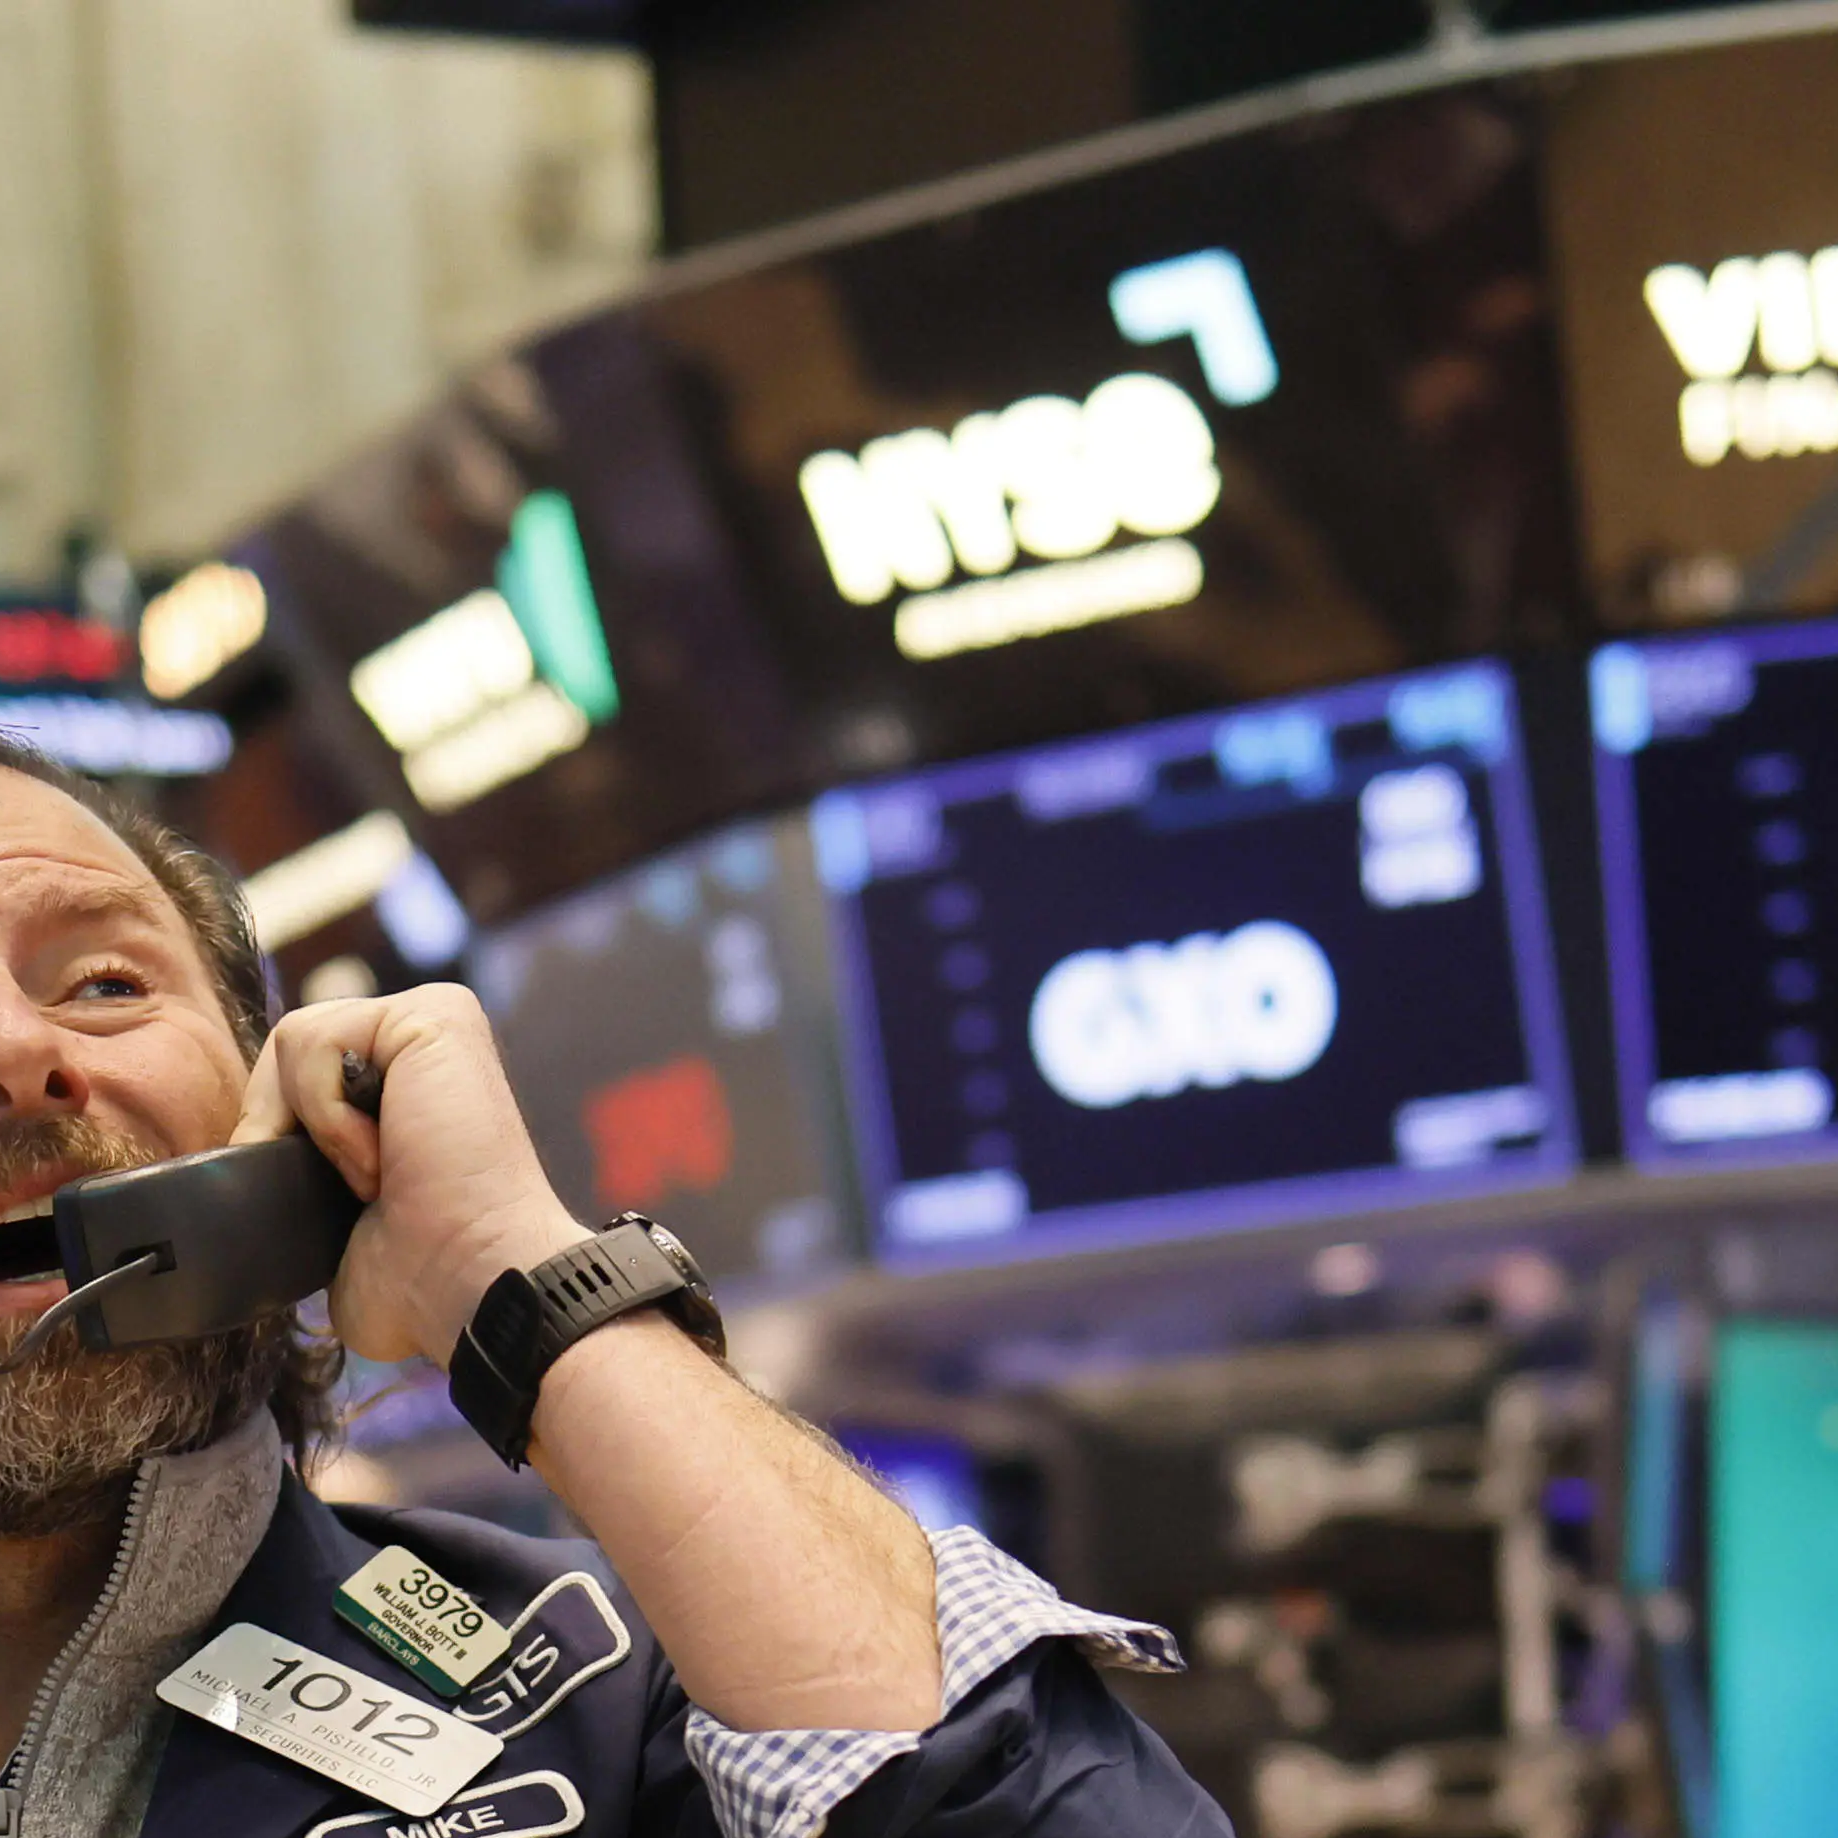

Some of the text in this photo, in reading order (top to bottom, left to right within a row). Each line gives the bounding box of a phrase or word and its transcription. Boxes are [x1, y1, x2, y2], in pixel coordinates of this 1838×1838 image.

[373, 1582, 417, 1620] WILLIAM
[415, 1618, 424, 1629] J.
[426, 1624, 458, 1652] BOTT
[382, 1609, 435, 1653] GOVERNOR
[399, 1568, 483, 1638] 3979
[368, 1622, 421, 1666] BARCLAYS
[452, 1633, 559, 1722] GTS
[191, 1670, 271, 1714] MICHAEL
[262, 1657, 440, 1756] 1012
[249, 1724, 341, 1771] SECURITIES
[346, 1769, 379, 1789] LLC
